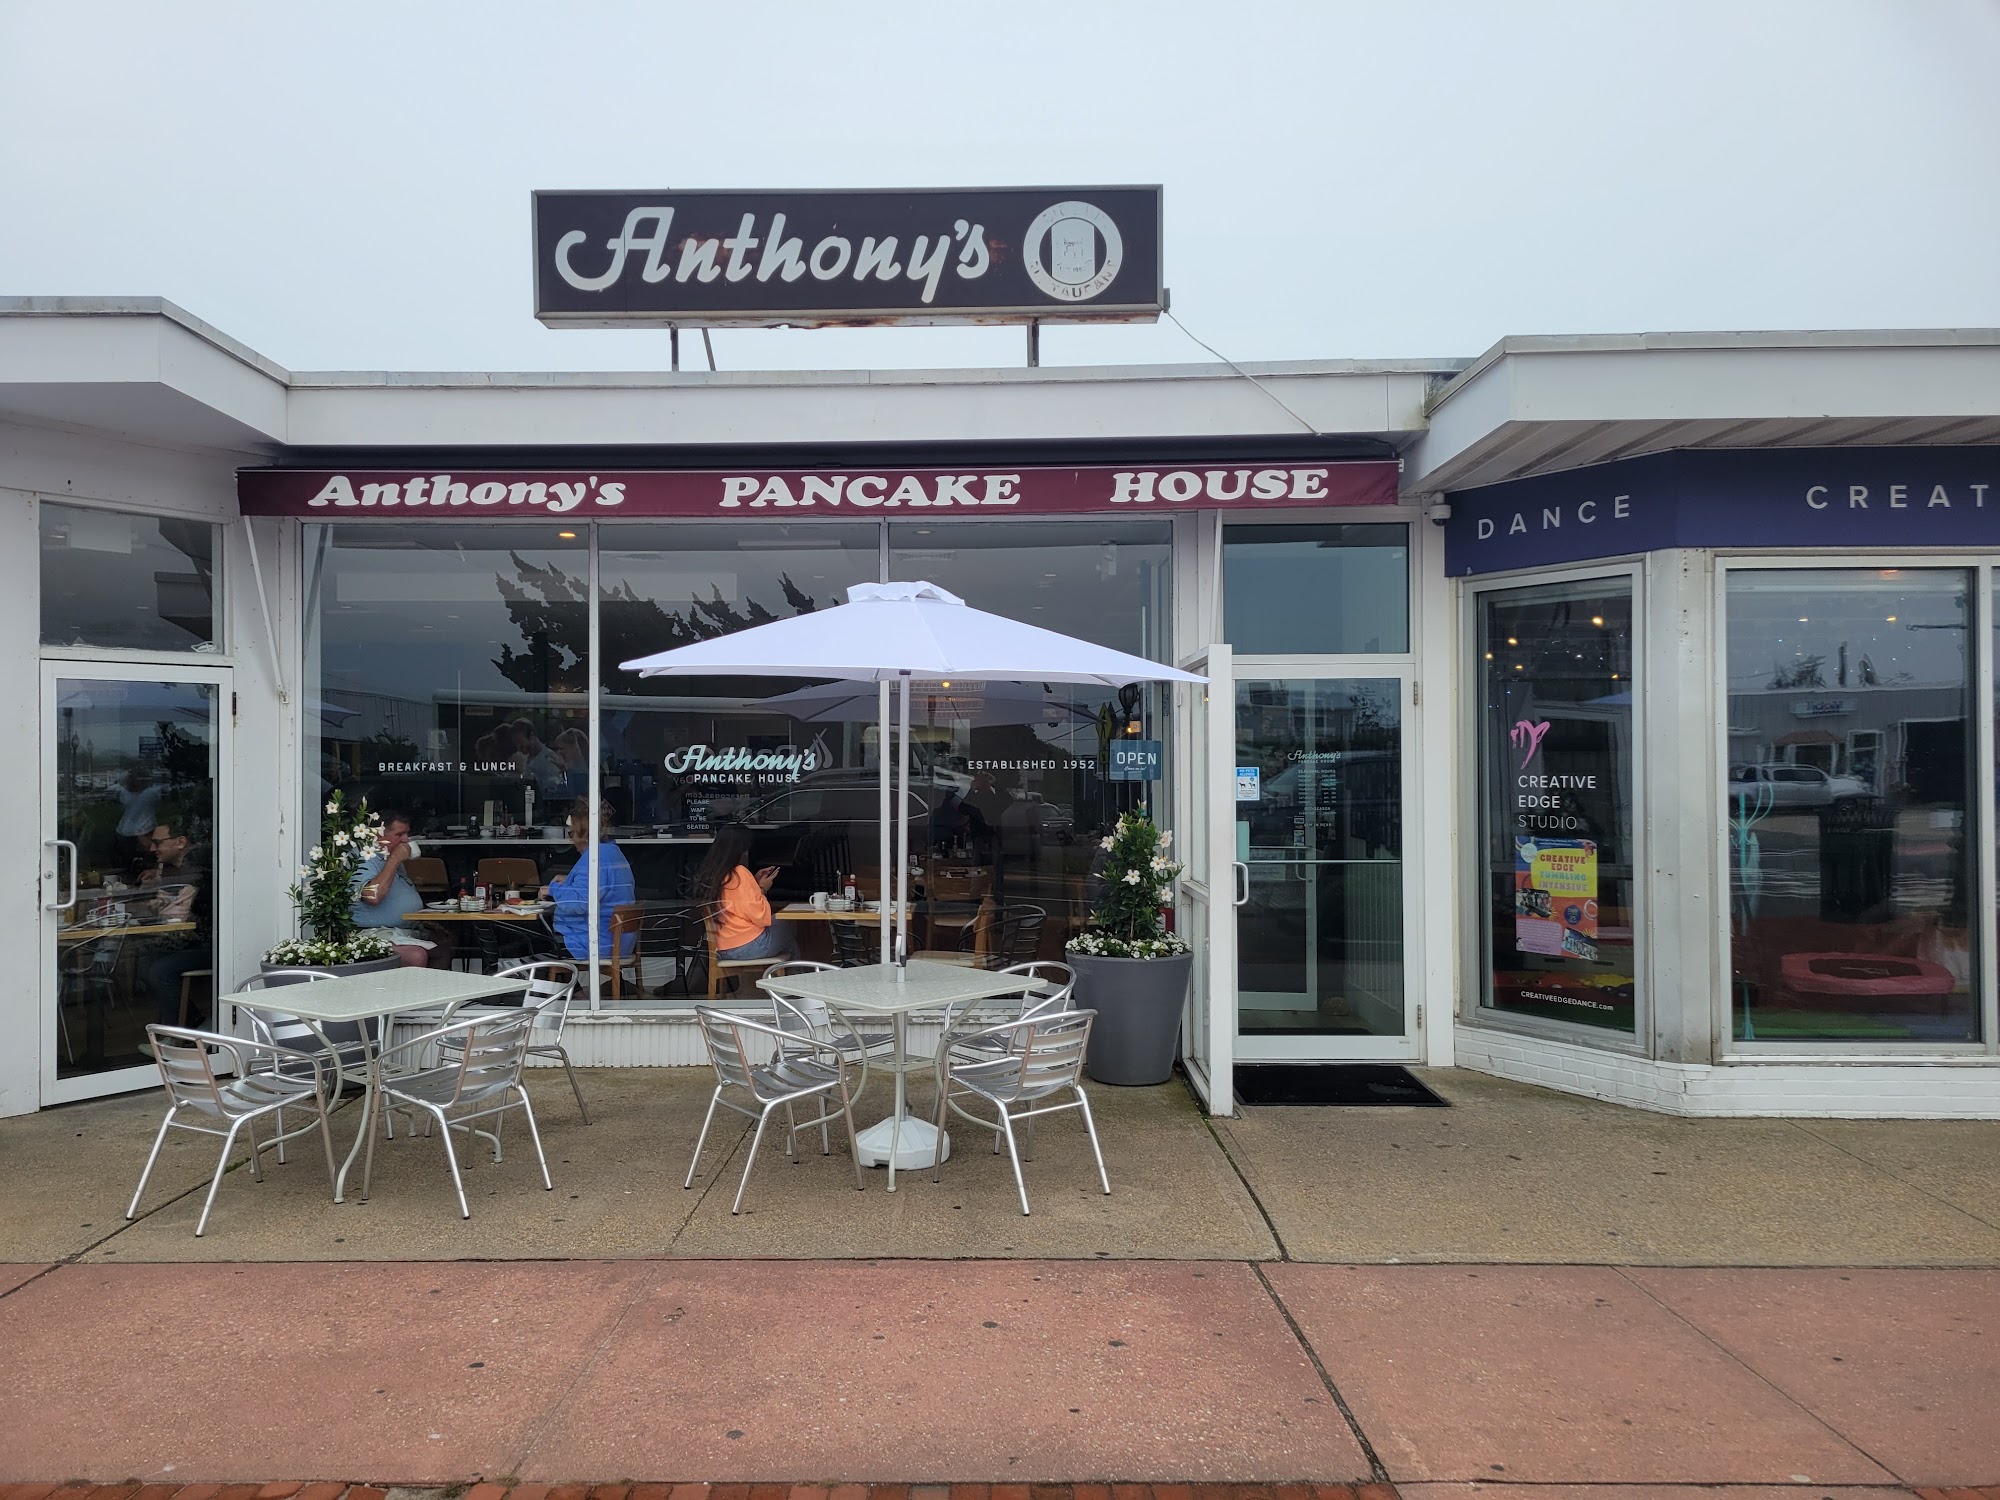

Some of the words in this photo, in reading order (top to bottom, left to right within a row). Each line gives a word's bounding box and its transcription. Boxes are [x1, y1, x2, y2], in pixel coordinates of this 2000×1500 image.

[555, 206, 989, 304] Anthony's
[307, 475, 626, 512] Anthony's
[719, 474, 1021, 508] PANCAKE
[1109, 469, 1329, 503] HOUSE
[1806, 484, 1989, 509] CREAT
[1477, 494, 1631, 540] DANCE
[664, 744, 816, 780] Anthony's
[1116, 751, 1157, 765] OPEN
[1287, 750, 1341, 762] Anthony's
[378, 762, 453, 772] BREAKFAST
[459, 761, 467, 772] &
[474, 761, 516, 771] LUNCH
[968, 760, 1056, 770] ESTABLISHED
[1063, 760, 1095, 770] 1952
[693, 773, 751, 783] PANCAKE
[758, 773, 801, 783] HOUSE
[1518, 775, 1597, 789] CREATIVE
[1518, 795, 1560, 809] EDGE
[1518, 814, 1577, 830] STUDIO
[1540, 853, 1586, 865] CREATIVE
[1551, 863, 1574, 872] EDGE
[1539, 881, 1587, 892] INTENSIVE
[1520, 990, 1614, 1011] CREATIVEEDGEDANCE.com
